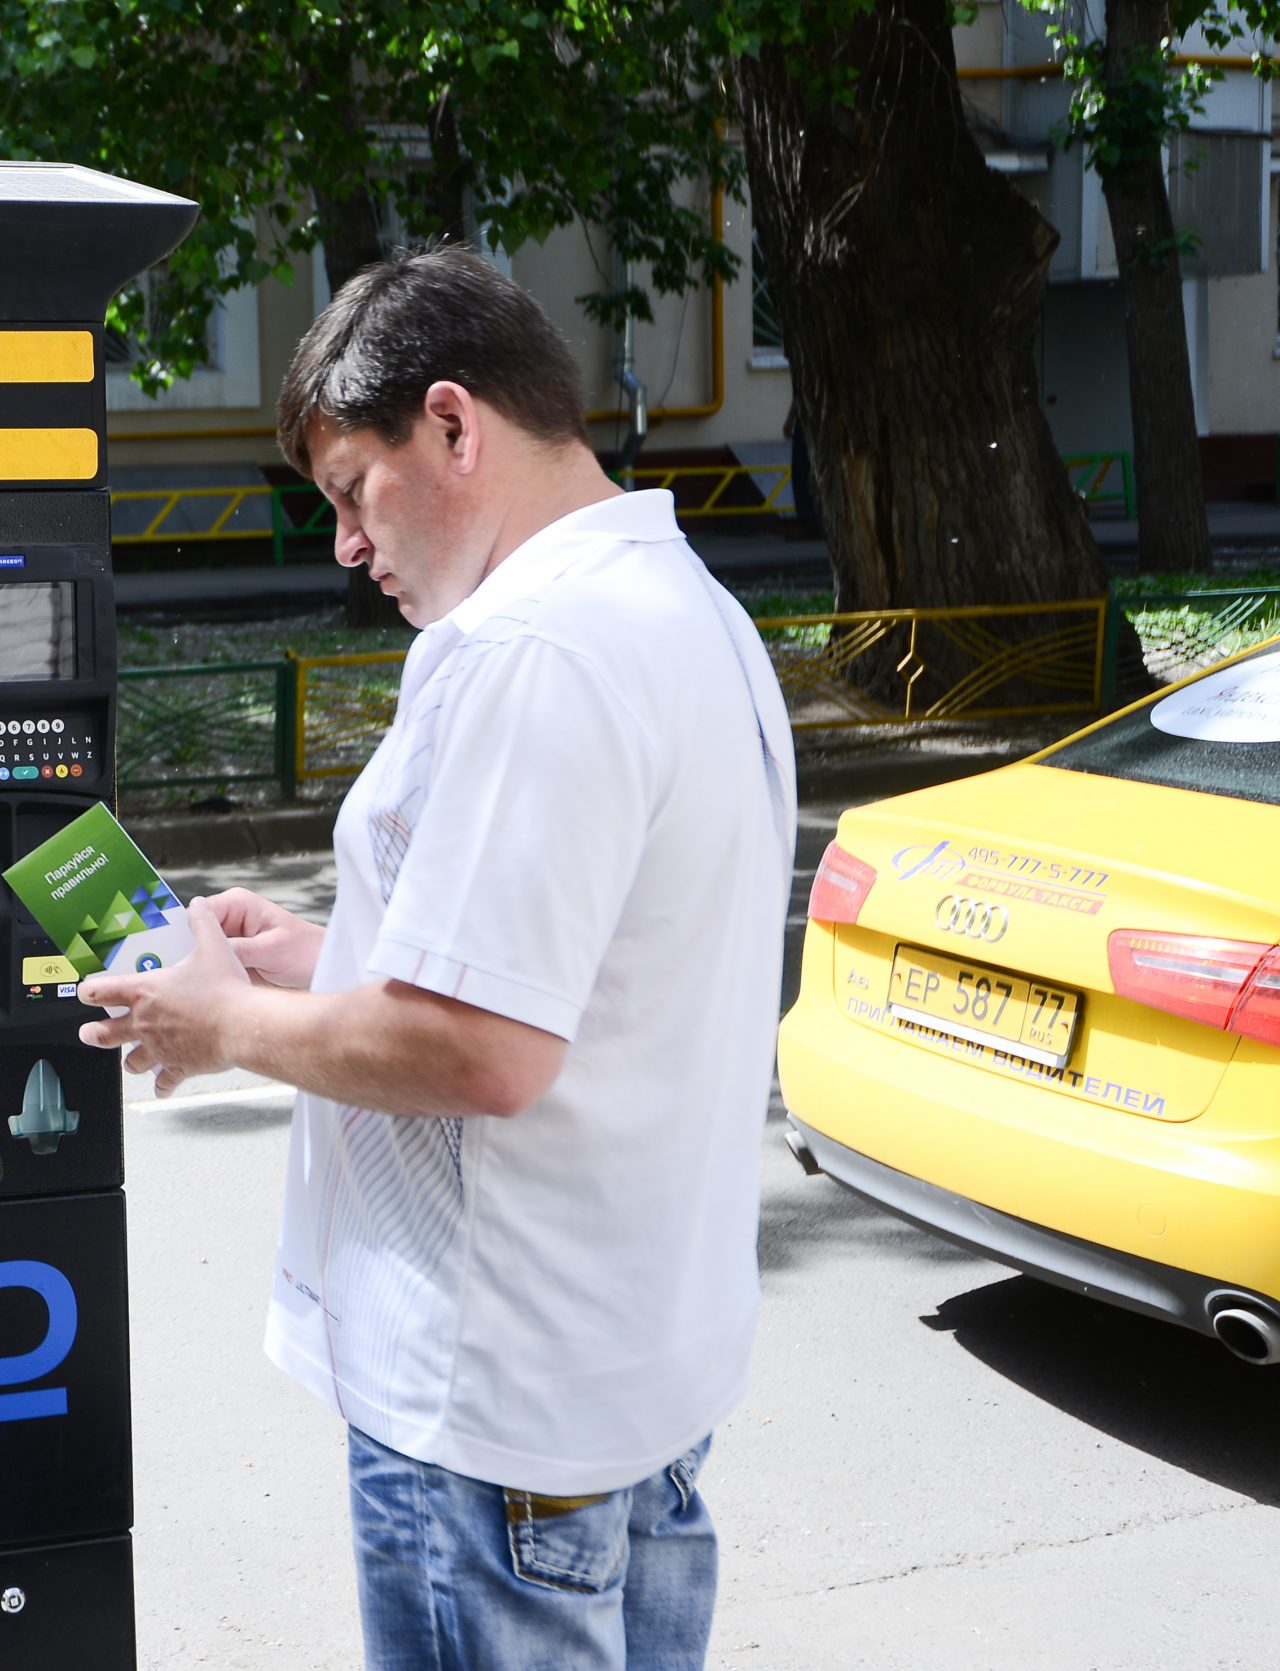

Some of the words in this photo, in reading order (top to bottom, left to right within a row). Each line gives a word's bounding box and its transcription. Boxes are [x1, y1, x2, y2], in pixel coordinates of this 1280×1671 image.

[0, 754, 5, 763] Q
[29, 753, 34, 761] S
[27, 738, 33, 746] G
[58, 737, 61, 745] J
[44, 845, 96, 885] Паркуйся
[51, 852, 109, 900] правильно!
[968, 847, 1109, 887] 495-777-5-777
[966, 876, 1036, 901] ФОРМУЛА
[1040, 892, 1093, 913] ТАКСИ
[60, 986, 75, 994] VISA
[953, 971, 1013, 1025] 587
[1032, 988, 1065, 1029] 77
[1029, 1028, 1053, 1046] RUS
